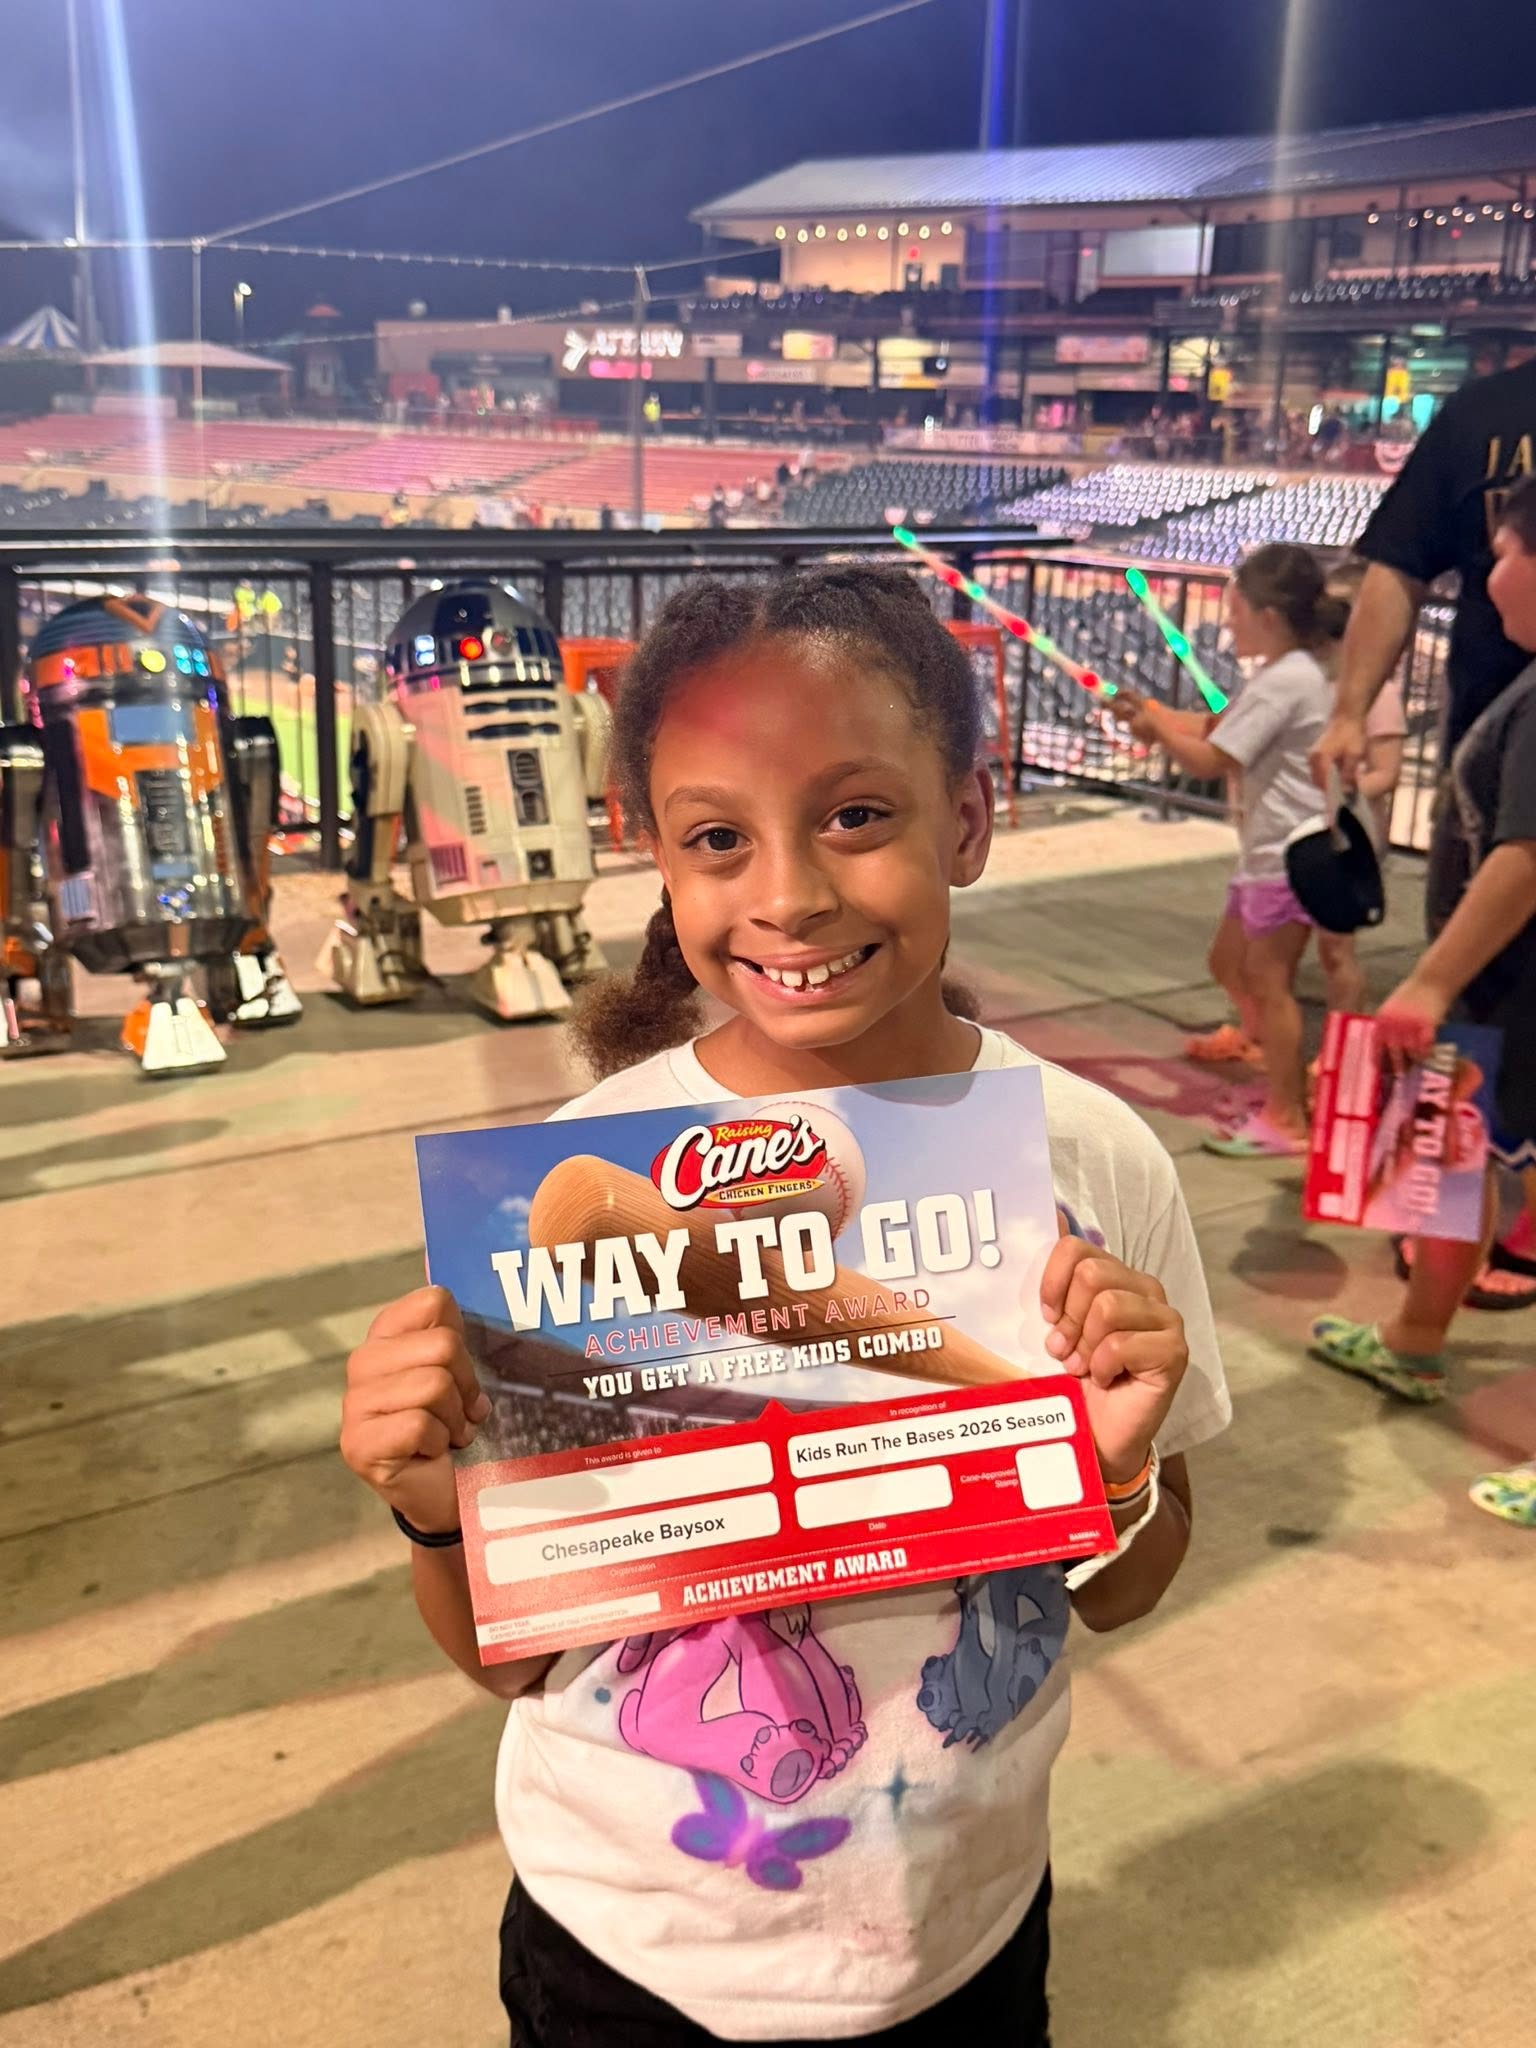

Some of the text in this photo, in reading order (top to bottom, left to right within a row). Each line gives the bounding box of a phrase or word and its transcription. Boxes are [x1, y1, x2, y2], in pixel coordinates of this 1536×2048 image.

[715, 1122, 773, 1143] Raising
[660, 1114, 826, 1209] Cane's
[719, 1185, 764, 1200] CHICKEN
[491, 1189, 1001, 1331] WAY TO GO!
[584, 1289, 931, 1358] ACHIEVEMENT AWARD
[583, 1326, 943, 1400] YOU GET A FREE KIDS COMBO
[889, 1401, 946, 1417] In recognition of
[584, 1446, 662, 1466] This award is given to
[796, 1411, 1066, 1463] Kids Run The Bases 2026 Season
[541, 1517, 726, 1562] Chesapeake Baysox
[682, 1561, 827, 1606] ACHIEVEMENT
[833, 1547, 908, 1579] AWARD
